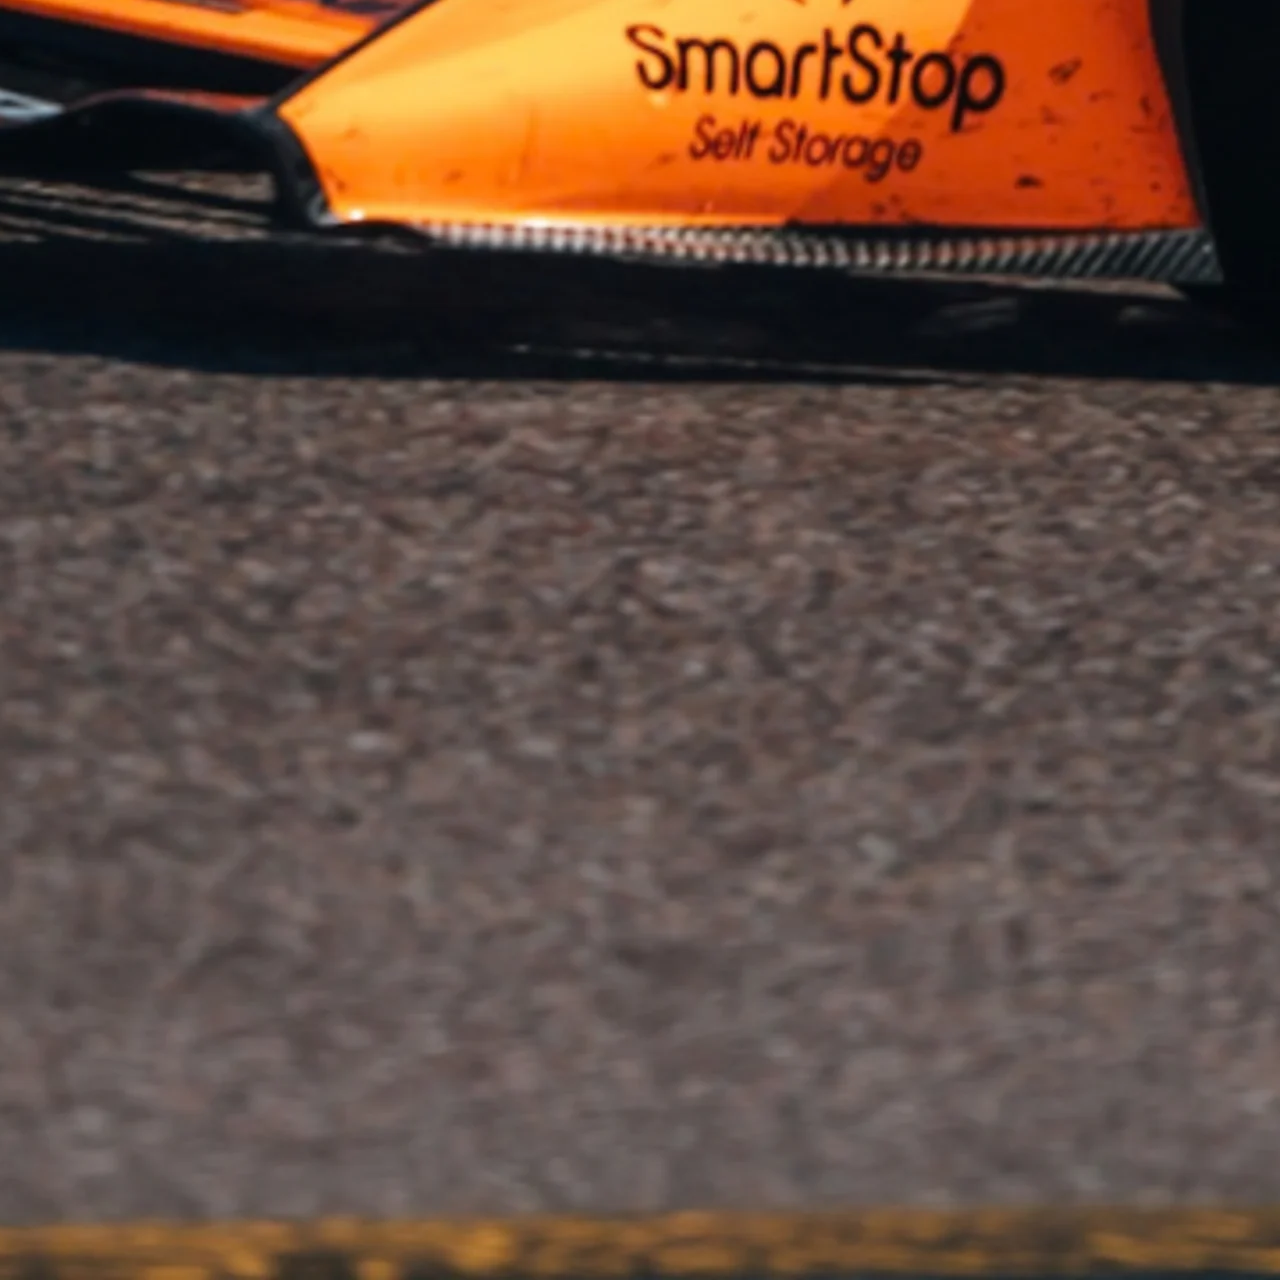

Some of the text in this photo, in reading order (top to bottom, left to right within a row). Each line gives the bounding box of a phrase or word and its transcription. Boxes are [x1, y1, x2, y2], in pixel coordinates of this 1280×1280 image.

[625, 22, 1006, 133] SmartStop
[688, 113, 924, 184] Self Storage
